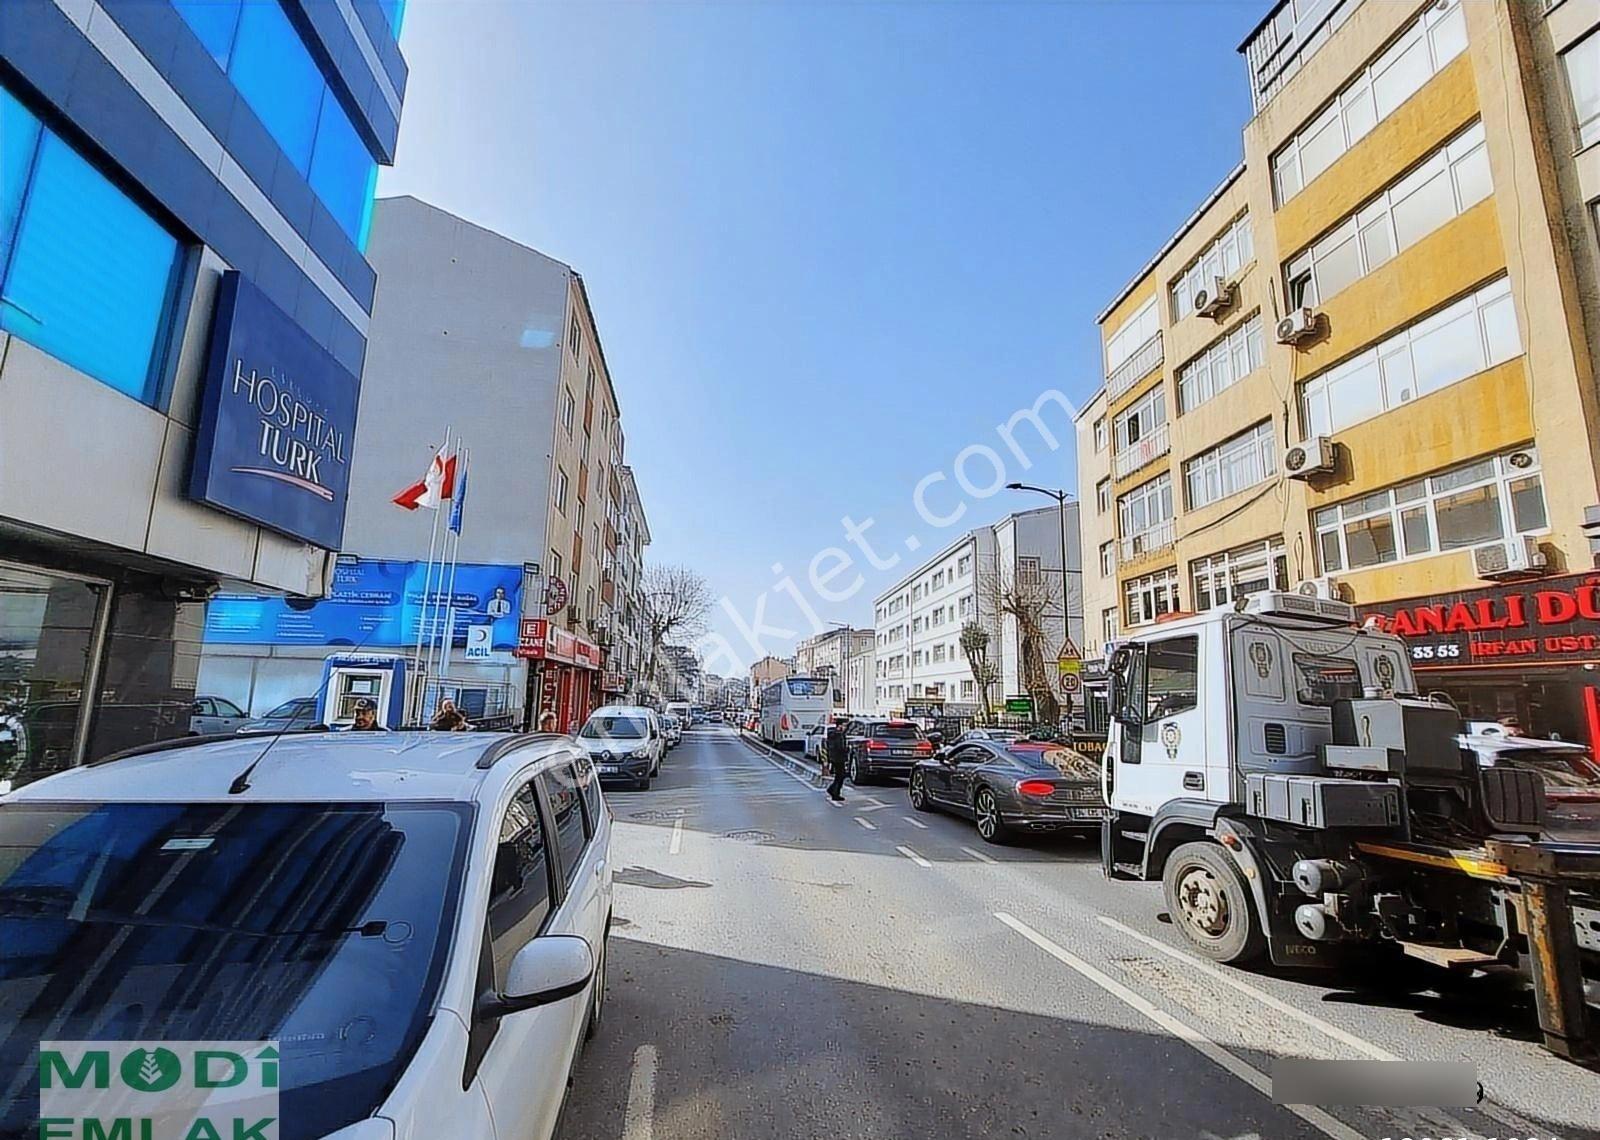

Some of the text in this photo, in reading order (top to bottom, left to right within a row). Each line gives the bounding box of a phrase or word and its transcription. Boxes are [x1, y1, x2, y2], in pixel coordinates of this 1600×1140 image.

[233, 359, 346, 464] HOSPITAL
[260, 419, 322, 484] TURK
[519, 637, 545, 648] CZANE
[1544, 635, 1600, 653] UST
